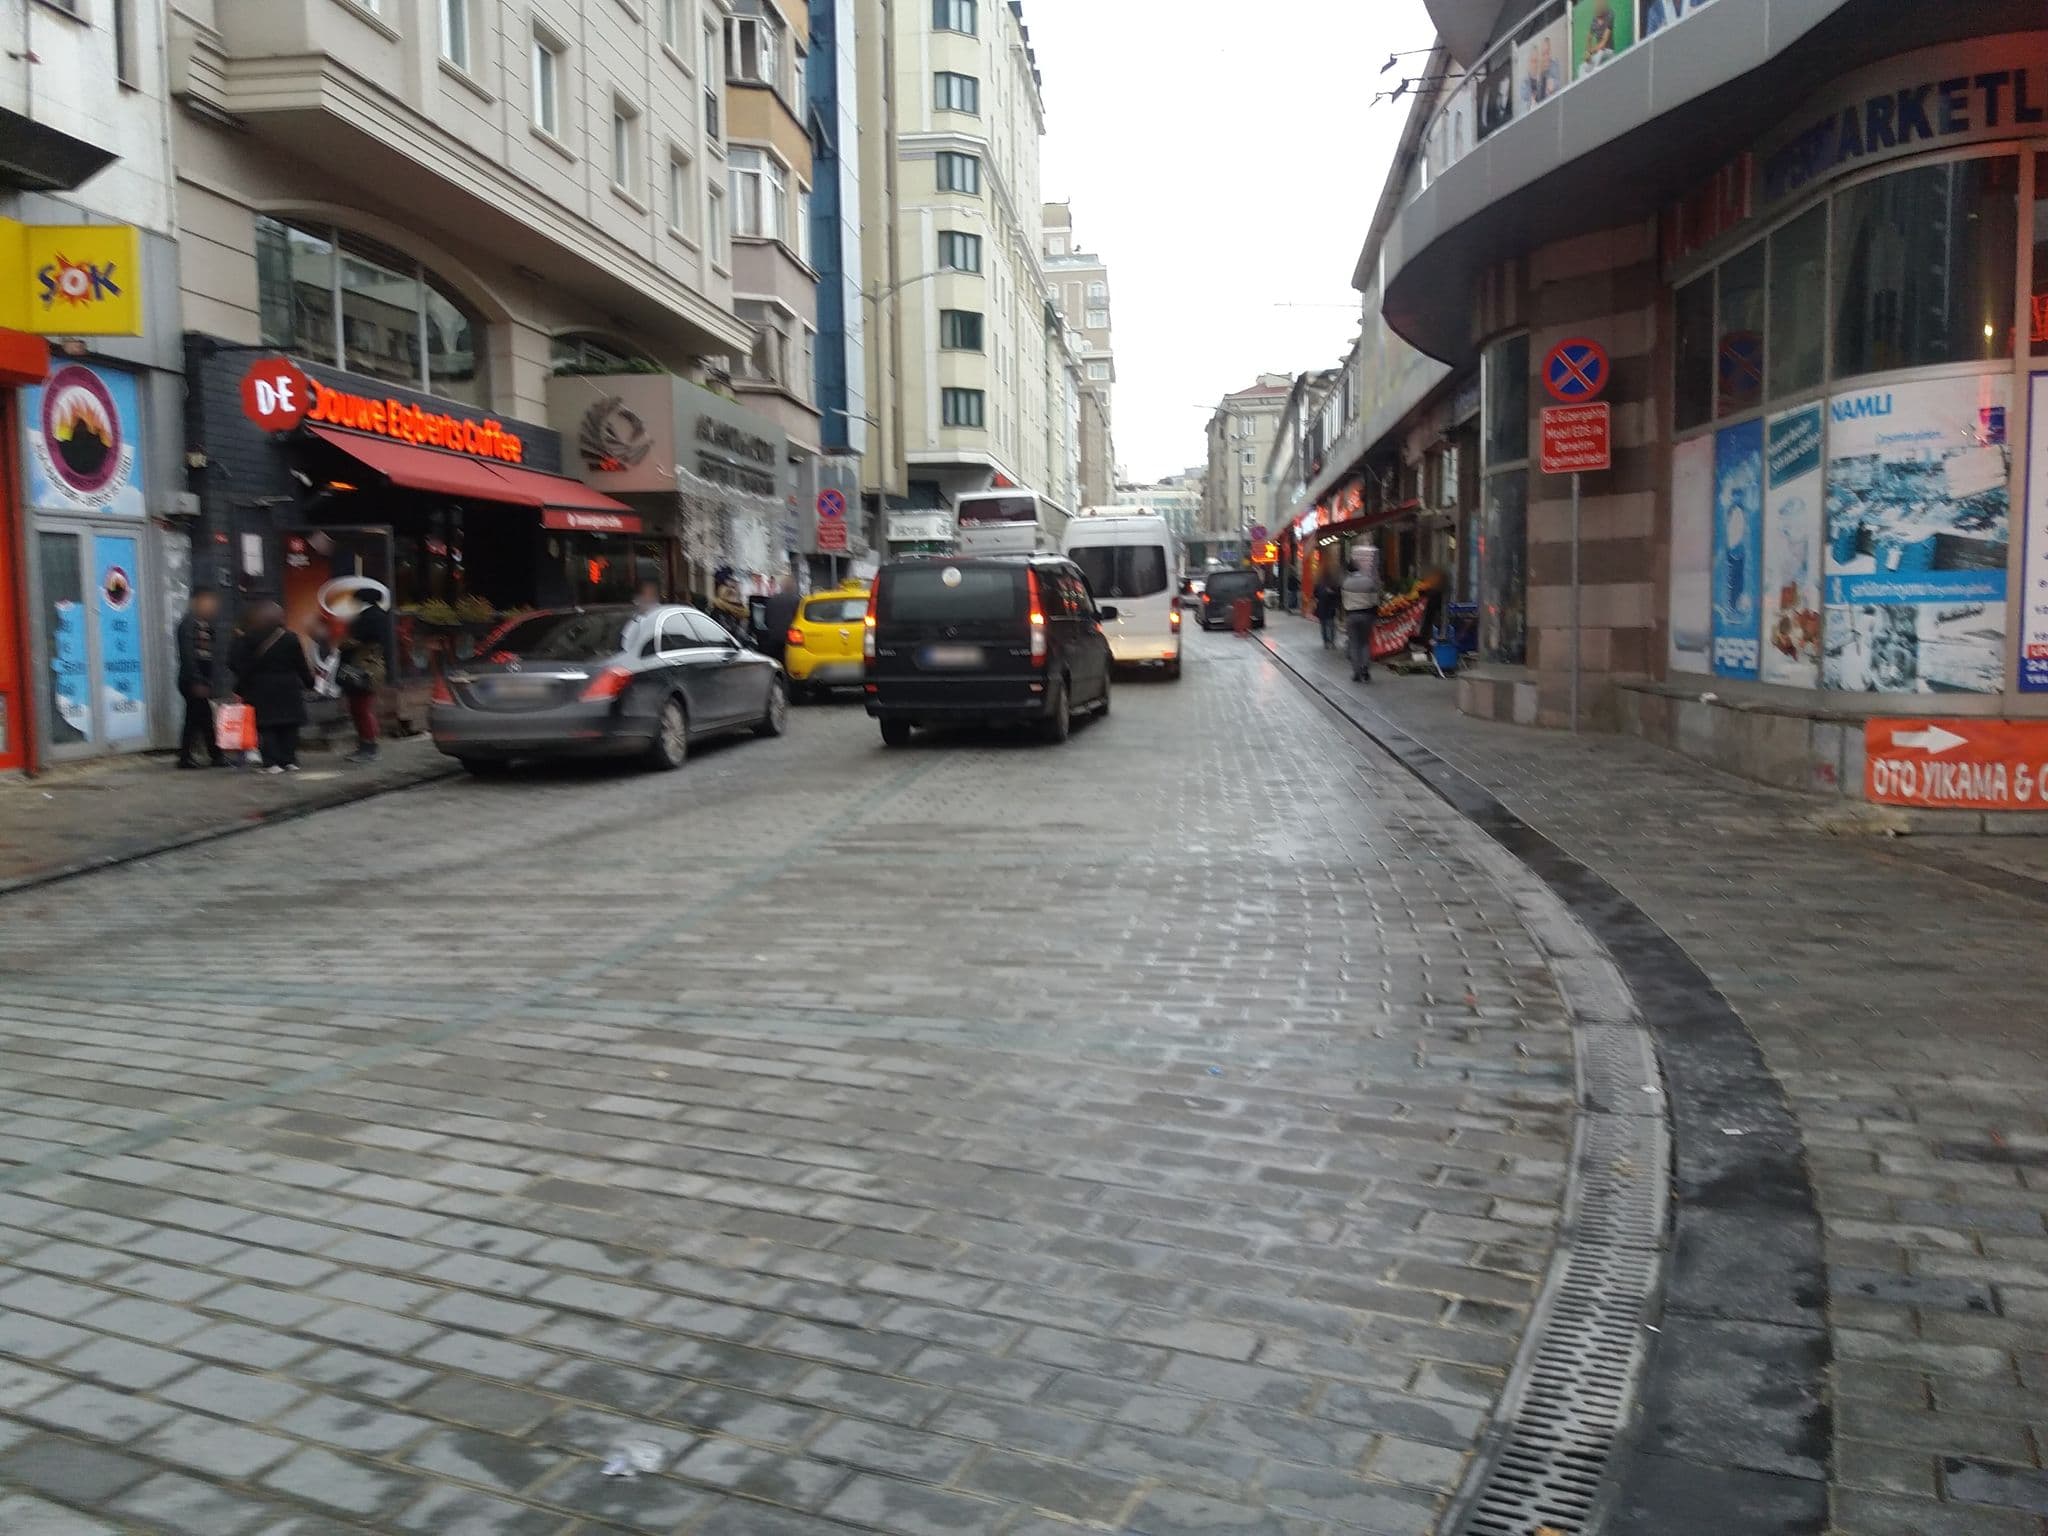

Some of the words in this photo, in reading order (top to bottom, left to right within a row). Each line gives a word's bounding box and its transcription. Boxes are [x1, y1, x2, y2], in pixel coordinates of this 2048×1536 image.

[463, 418, 523, 463] Coffee
[1873, 758, 1917, 797] OTO
[1921, 760, 2008, 800] YIKAMA
[2014, 762, 2034, 802] &
